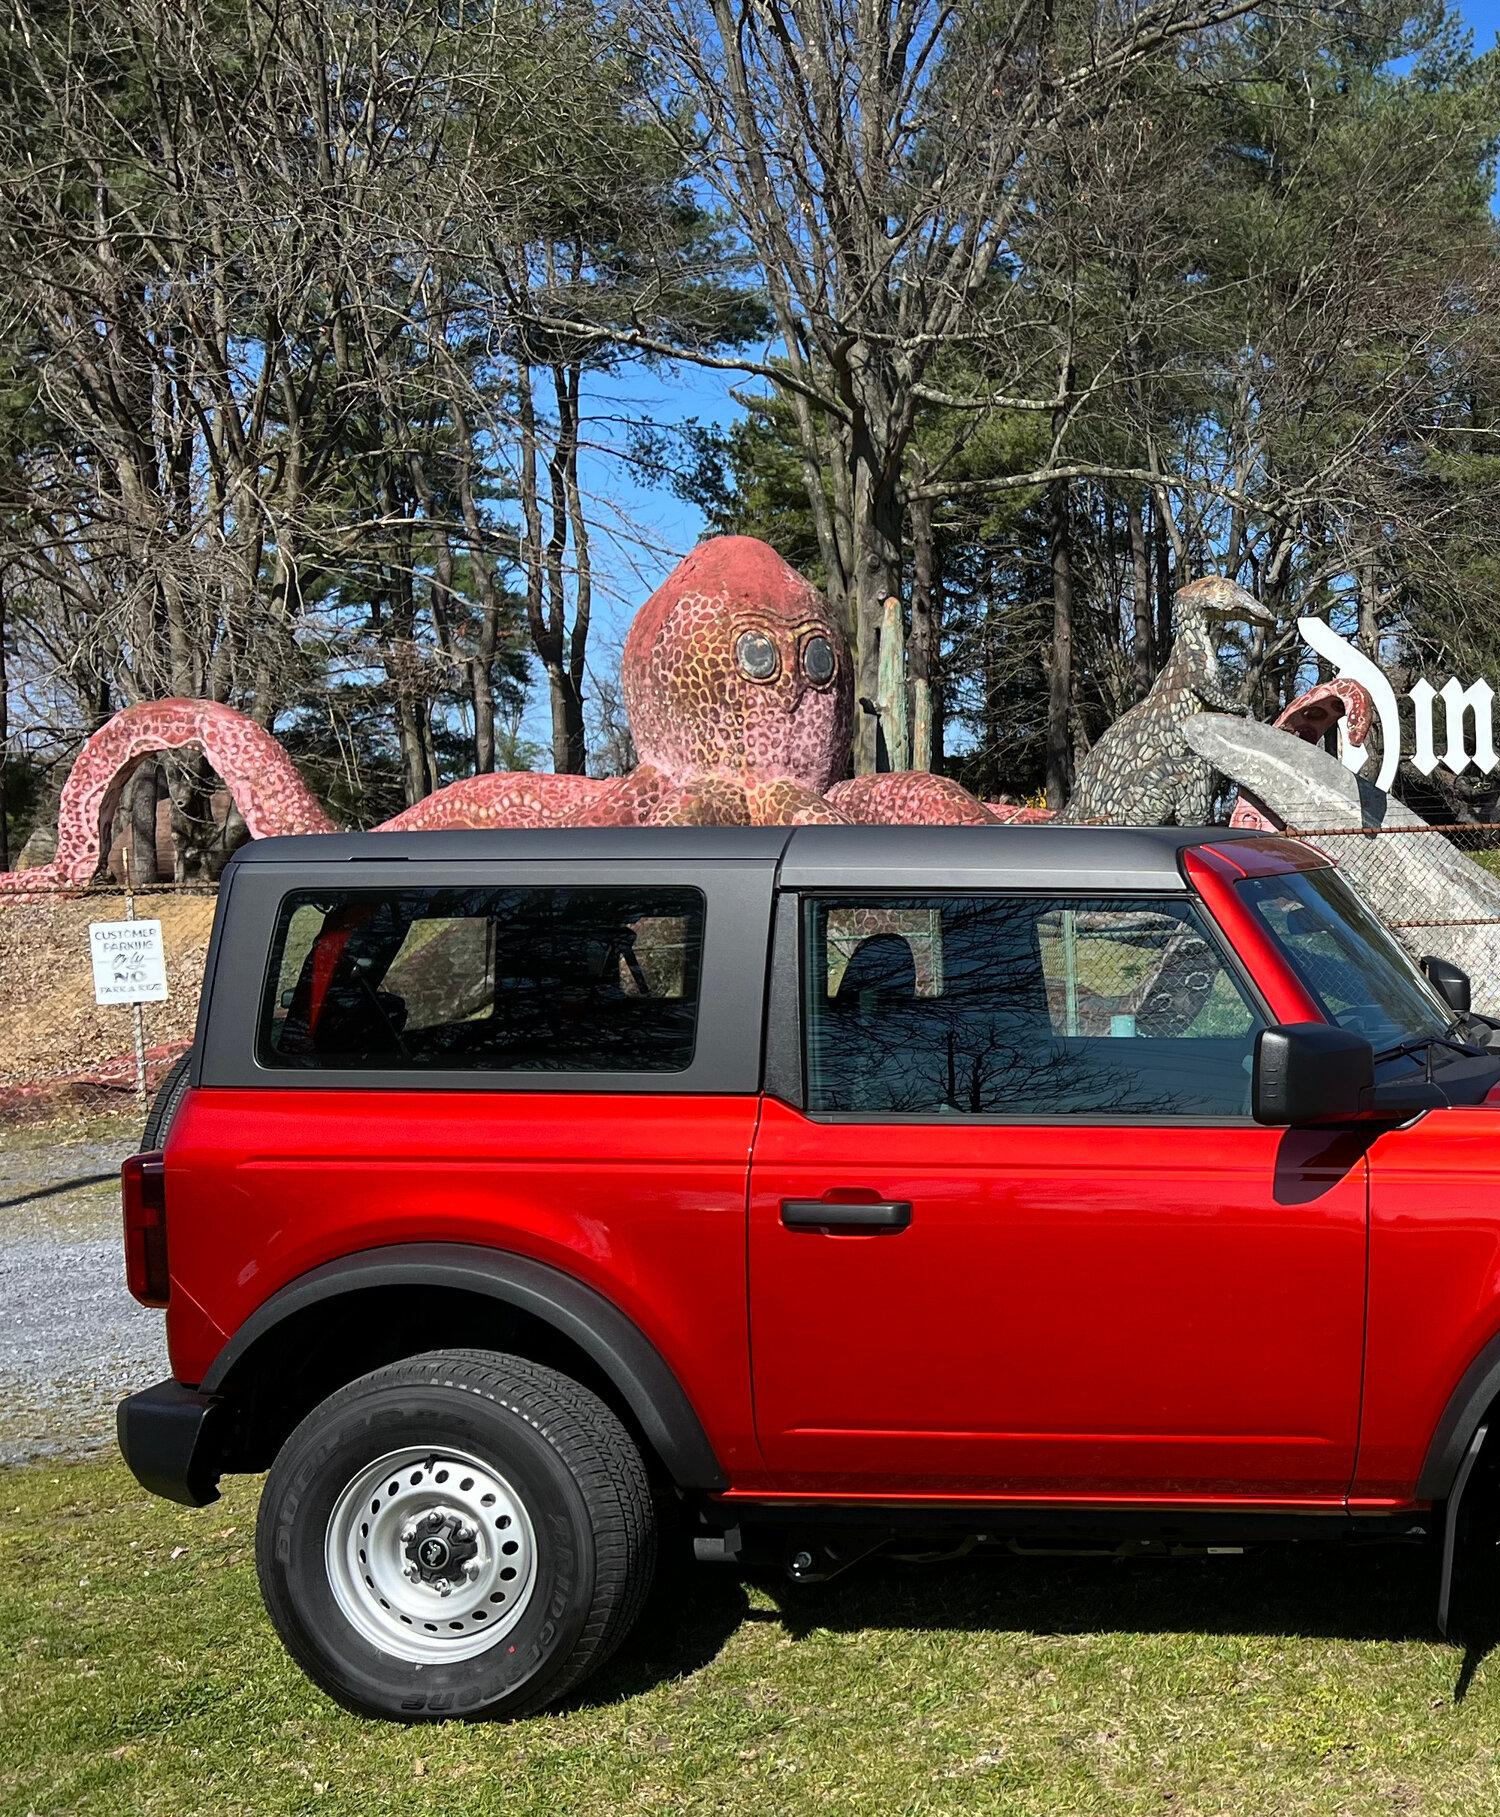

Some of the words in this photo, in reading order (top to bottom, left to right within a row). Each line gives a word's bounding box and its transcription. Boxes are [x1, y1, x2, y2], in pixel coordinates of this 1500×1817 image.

[95, 928, 157, 940] CUSTOMER
[103, 940, 154, 952] PARKING
[113, 971, 147, 983] NO
